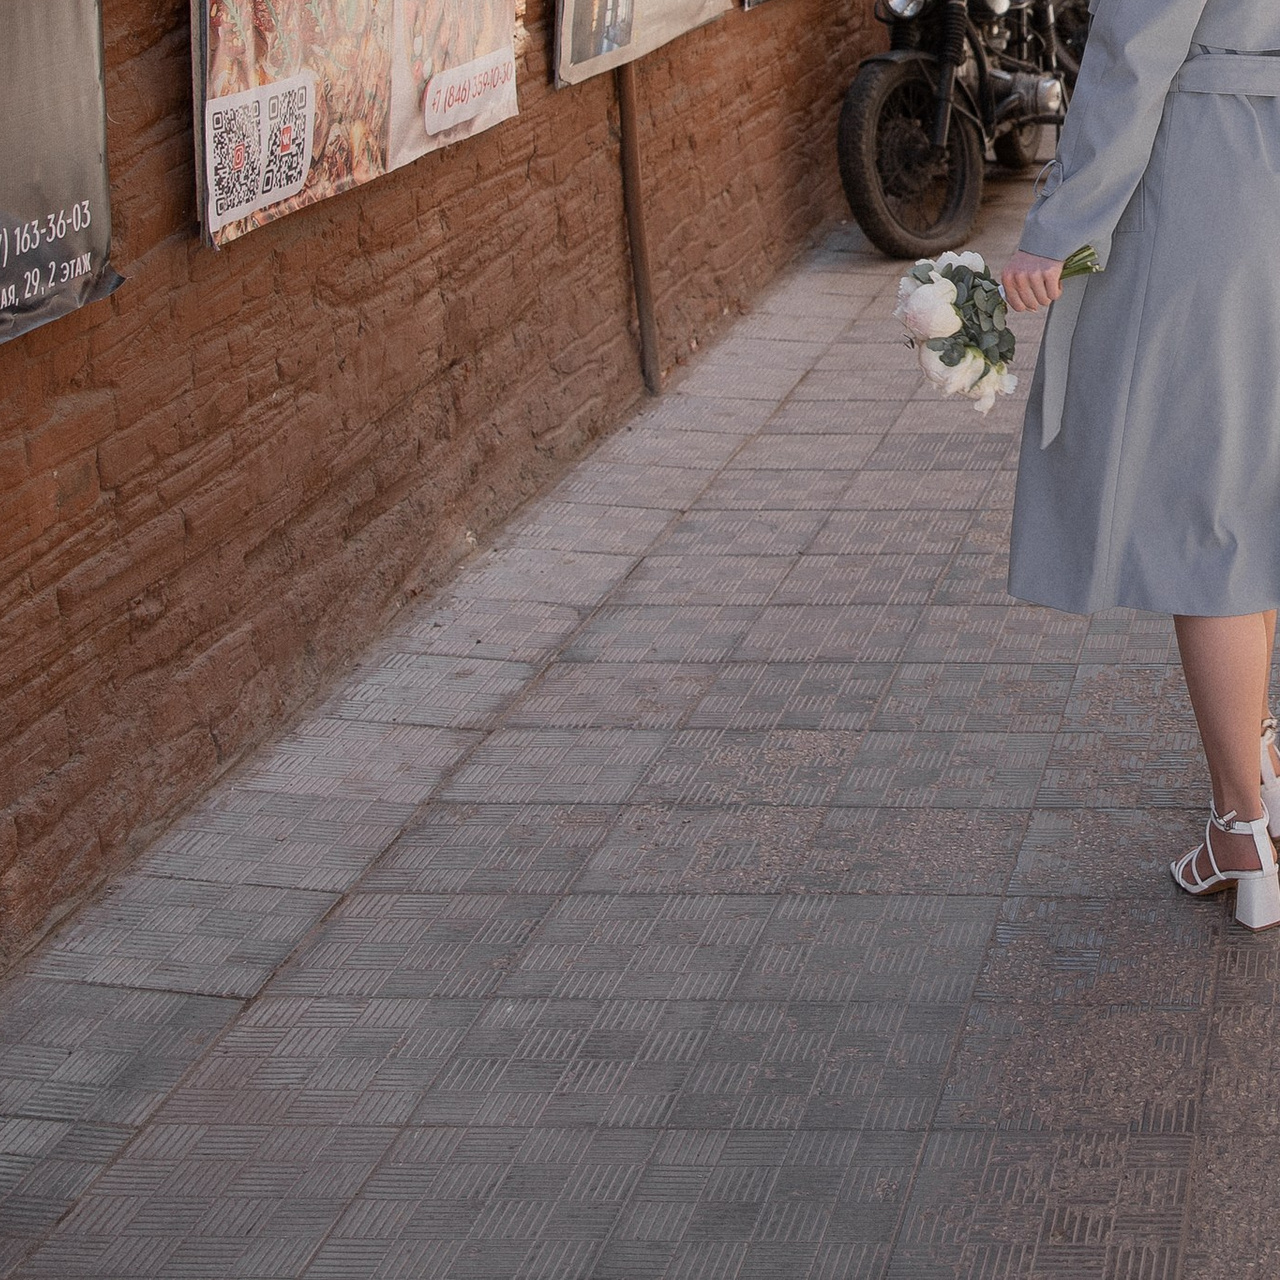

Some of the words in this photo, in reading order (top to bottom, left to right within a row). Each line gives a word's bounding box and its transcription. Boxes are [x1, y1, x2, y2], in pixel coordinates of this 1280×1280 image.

[444, 78, 471, 114] (846)
[14, 199, 91, 256] 163-36-03
[24, 267, 45, 299] 29,
[48, 261, 56, 289] 2
[60, 252, 92, 283] ЭТАЖ
